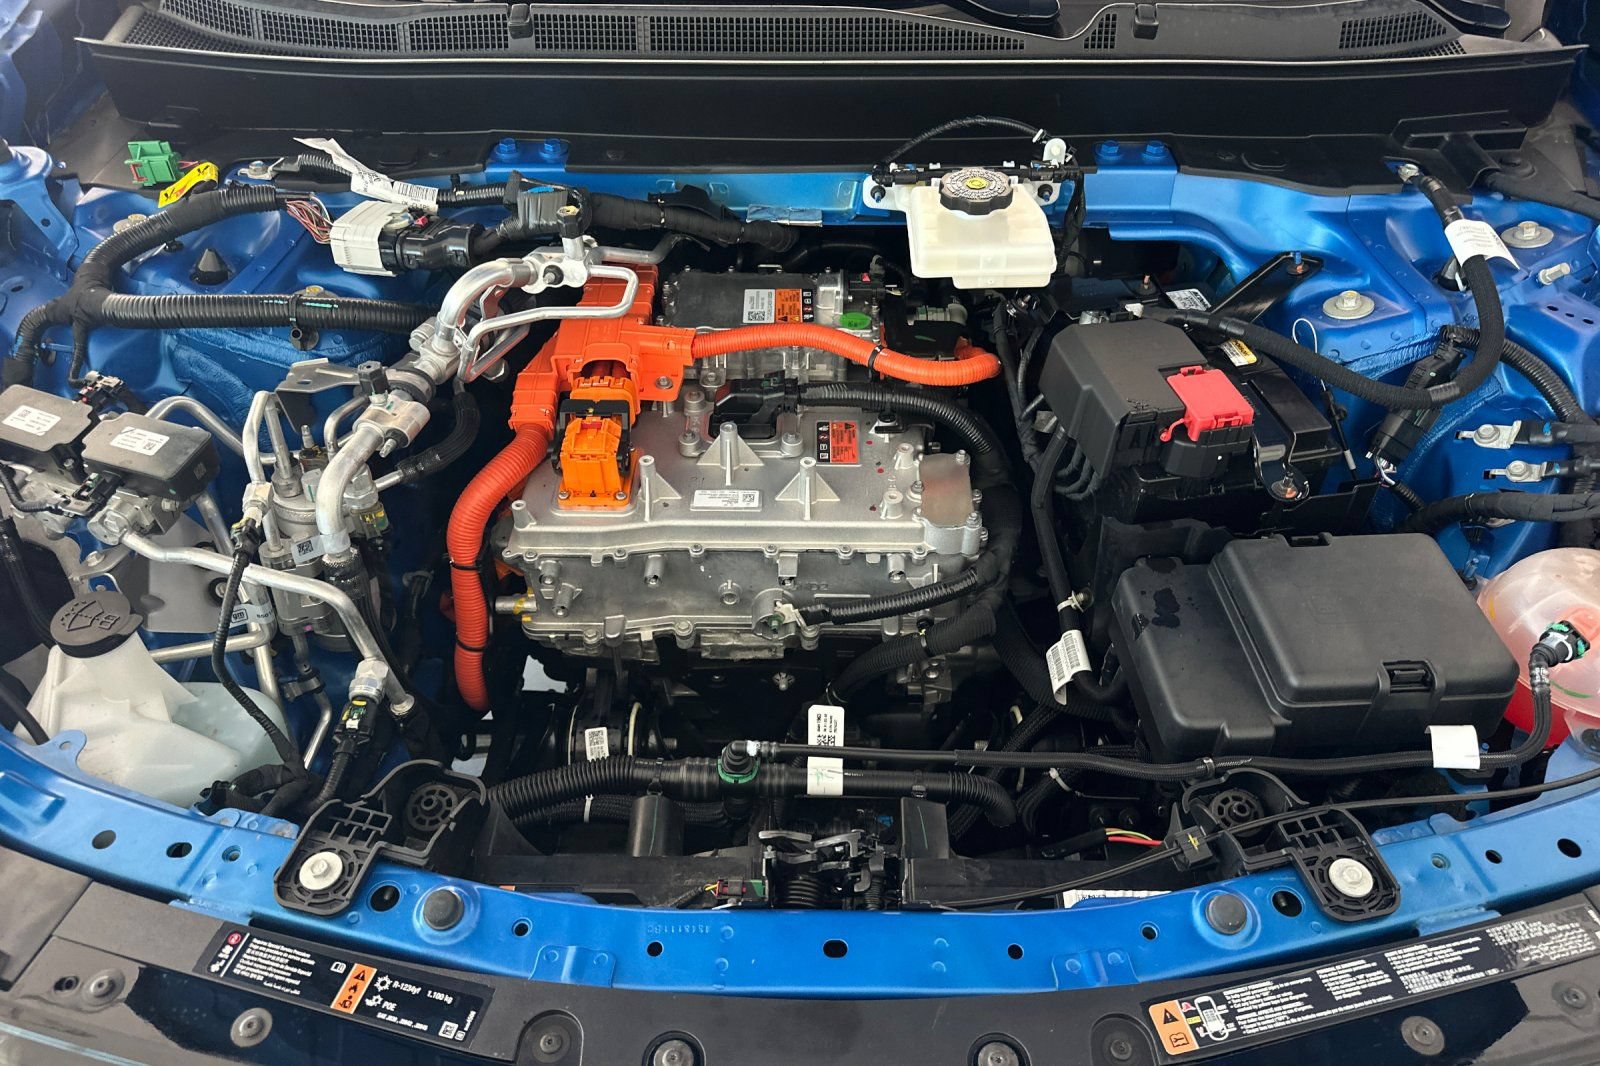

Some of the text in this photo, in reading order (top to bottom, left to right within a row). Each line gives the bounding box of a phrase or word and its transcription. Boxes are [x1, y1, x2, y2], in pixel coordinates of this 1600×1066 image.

[233, 612, 245, 620] gm
[393, 981, 453, 1004] R-1234yf 1.100 kg
[382, 1001, 397, 1011] POE
